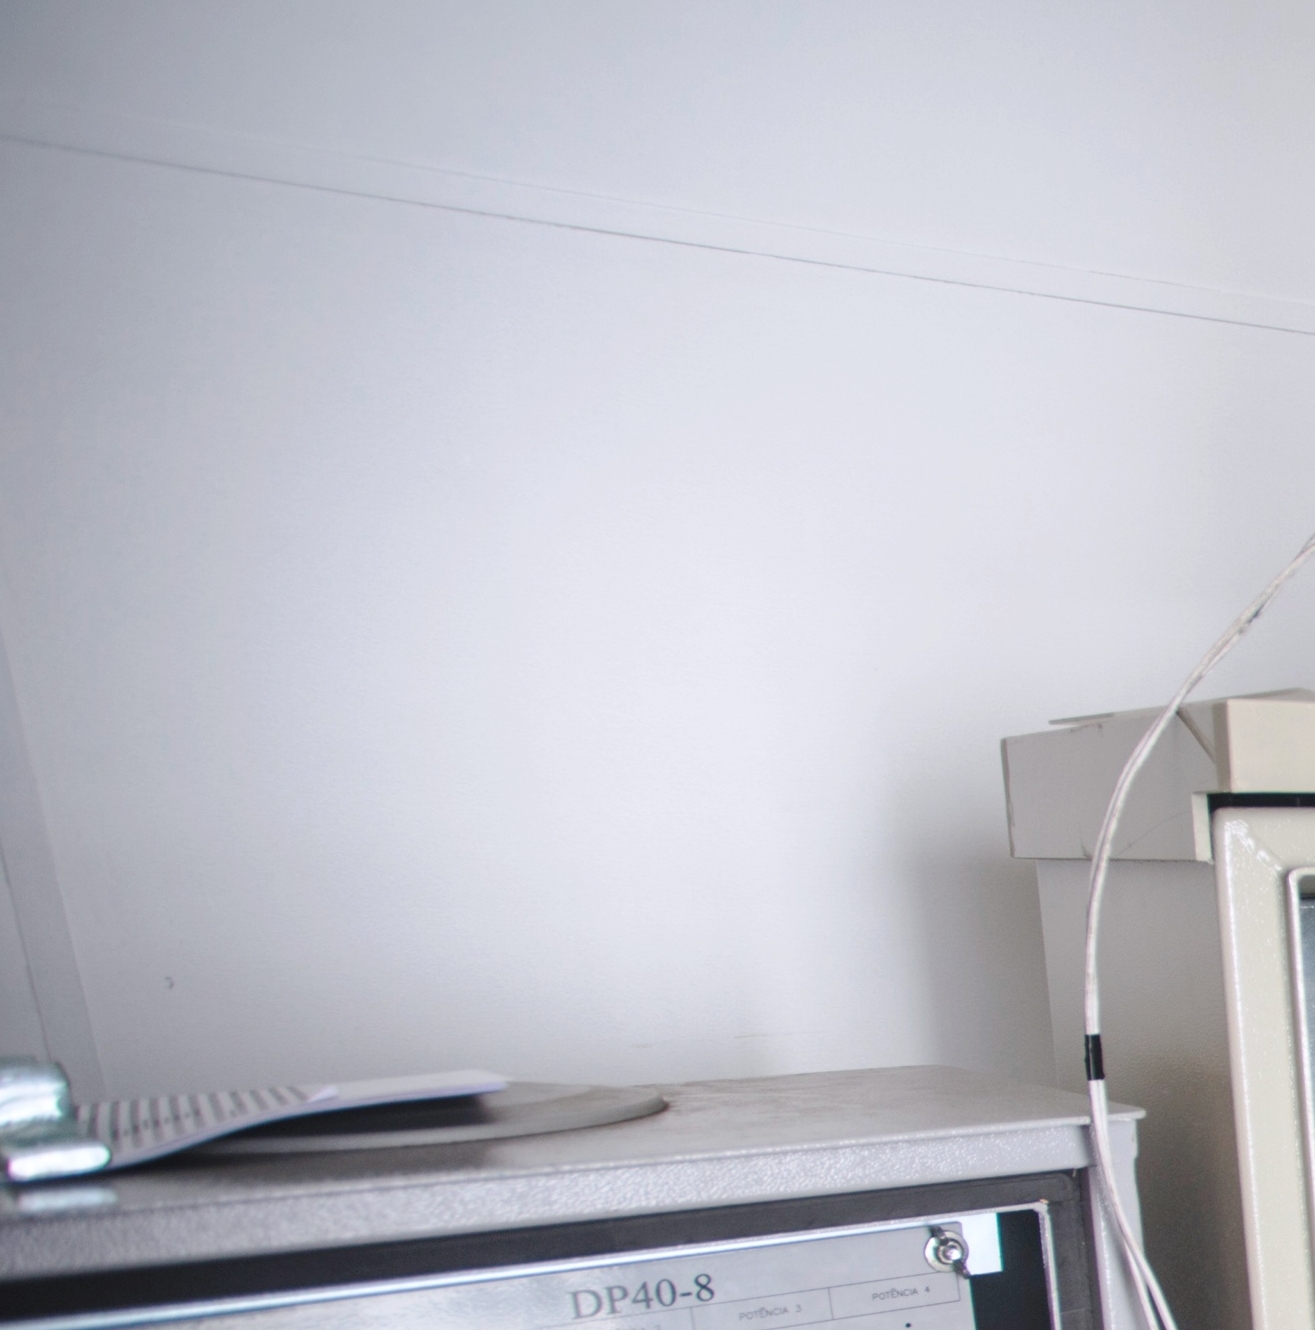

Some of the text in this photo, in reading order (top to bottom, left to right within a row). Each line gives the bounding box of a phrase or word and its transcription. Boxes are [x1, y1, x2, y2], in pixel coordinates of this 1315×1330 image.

[570, 1272, 716, 1320] DP40-8
[872, 1286, 931, 1301] POTÊNCIA 4
[738, 1304, 802, 1321] POTÊNCIA 3
